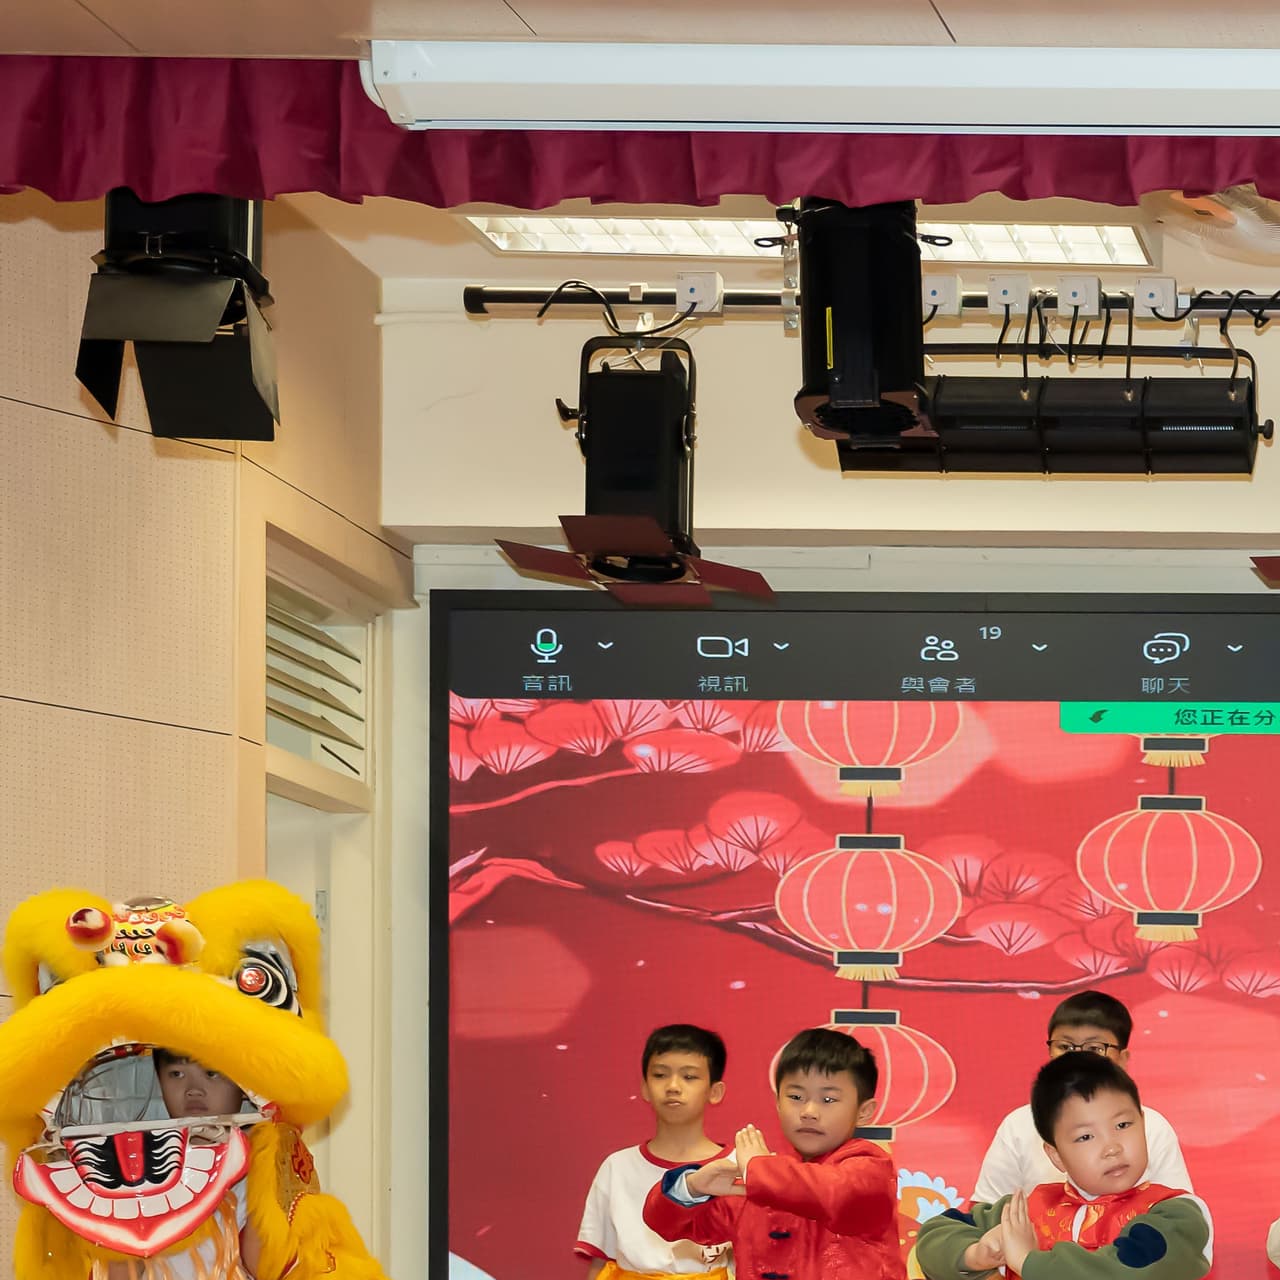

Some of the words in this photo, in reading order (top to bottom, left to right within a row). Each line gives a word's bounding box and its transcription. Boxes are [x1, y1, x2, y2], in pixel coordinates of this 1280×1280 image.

[978, 626, 1002, 640] 19
[522, 675, 573, 692] 音訊
[698, 676, 749, 693] 視訊
[900, 676, 977, 694] 與會者
[1141, 676, 1190, 694] 聊天
